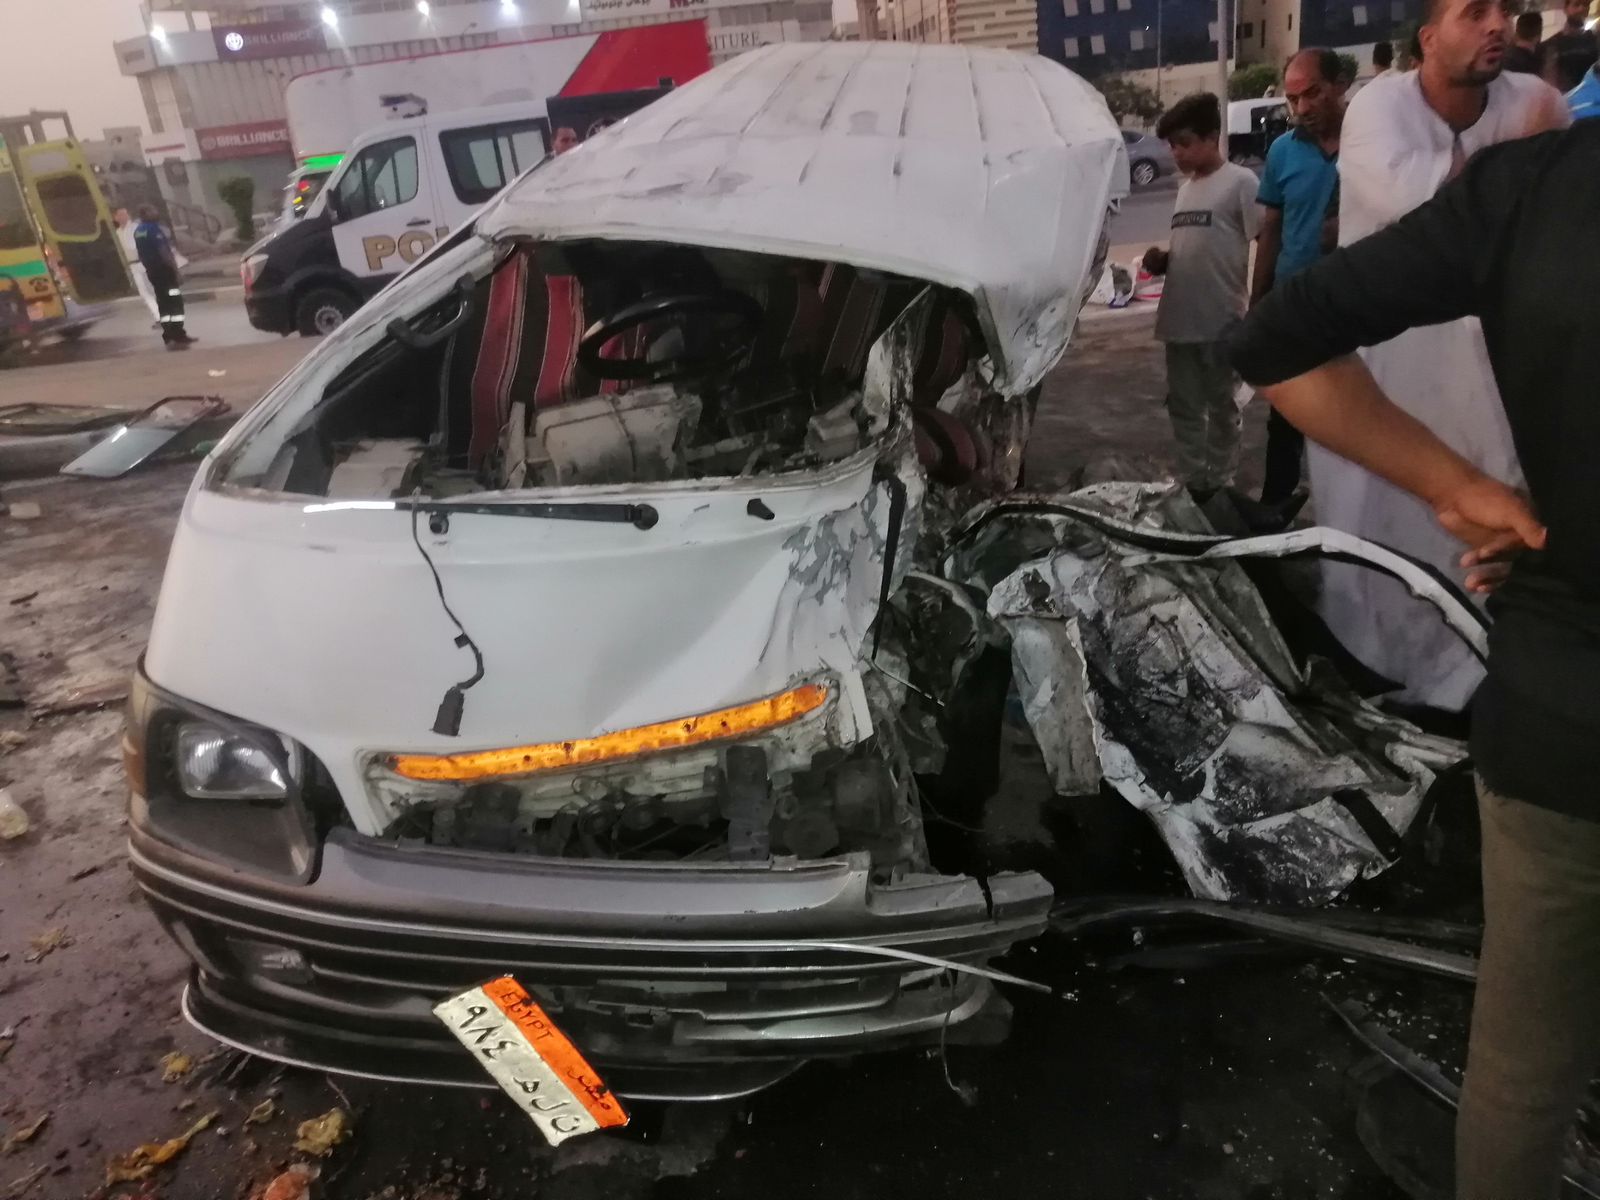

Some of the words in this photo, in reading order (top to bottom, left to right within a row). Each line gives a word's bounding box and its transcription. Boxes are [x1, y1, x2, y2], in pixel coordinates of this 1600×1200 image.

[709, 31, 761, 49] ITURE
[216, 128, 289, 147] BRILLIANCE
[459, 1005, 521, 1061] ٩٨٤
[500, 991, 554, 1040] EGYPT
[567, 1066, 612, 1111] مصر
